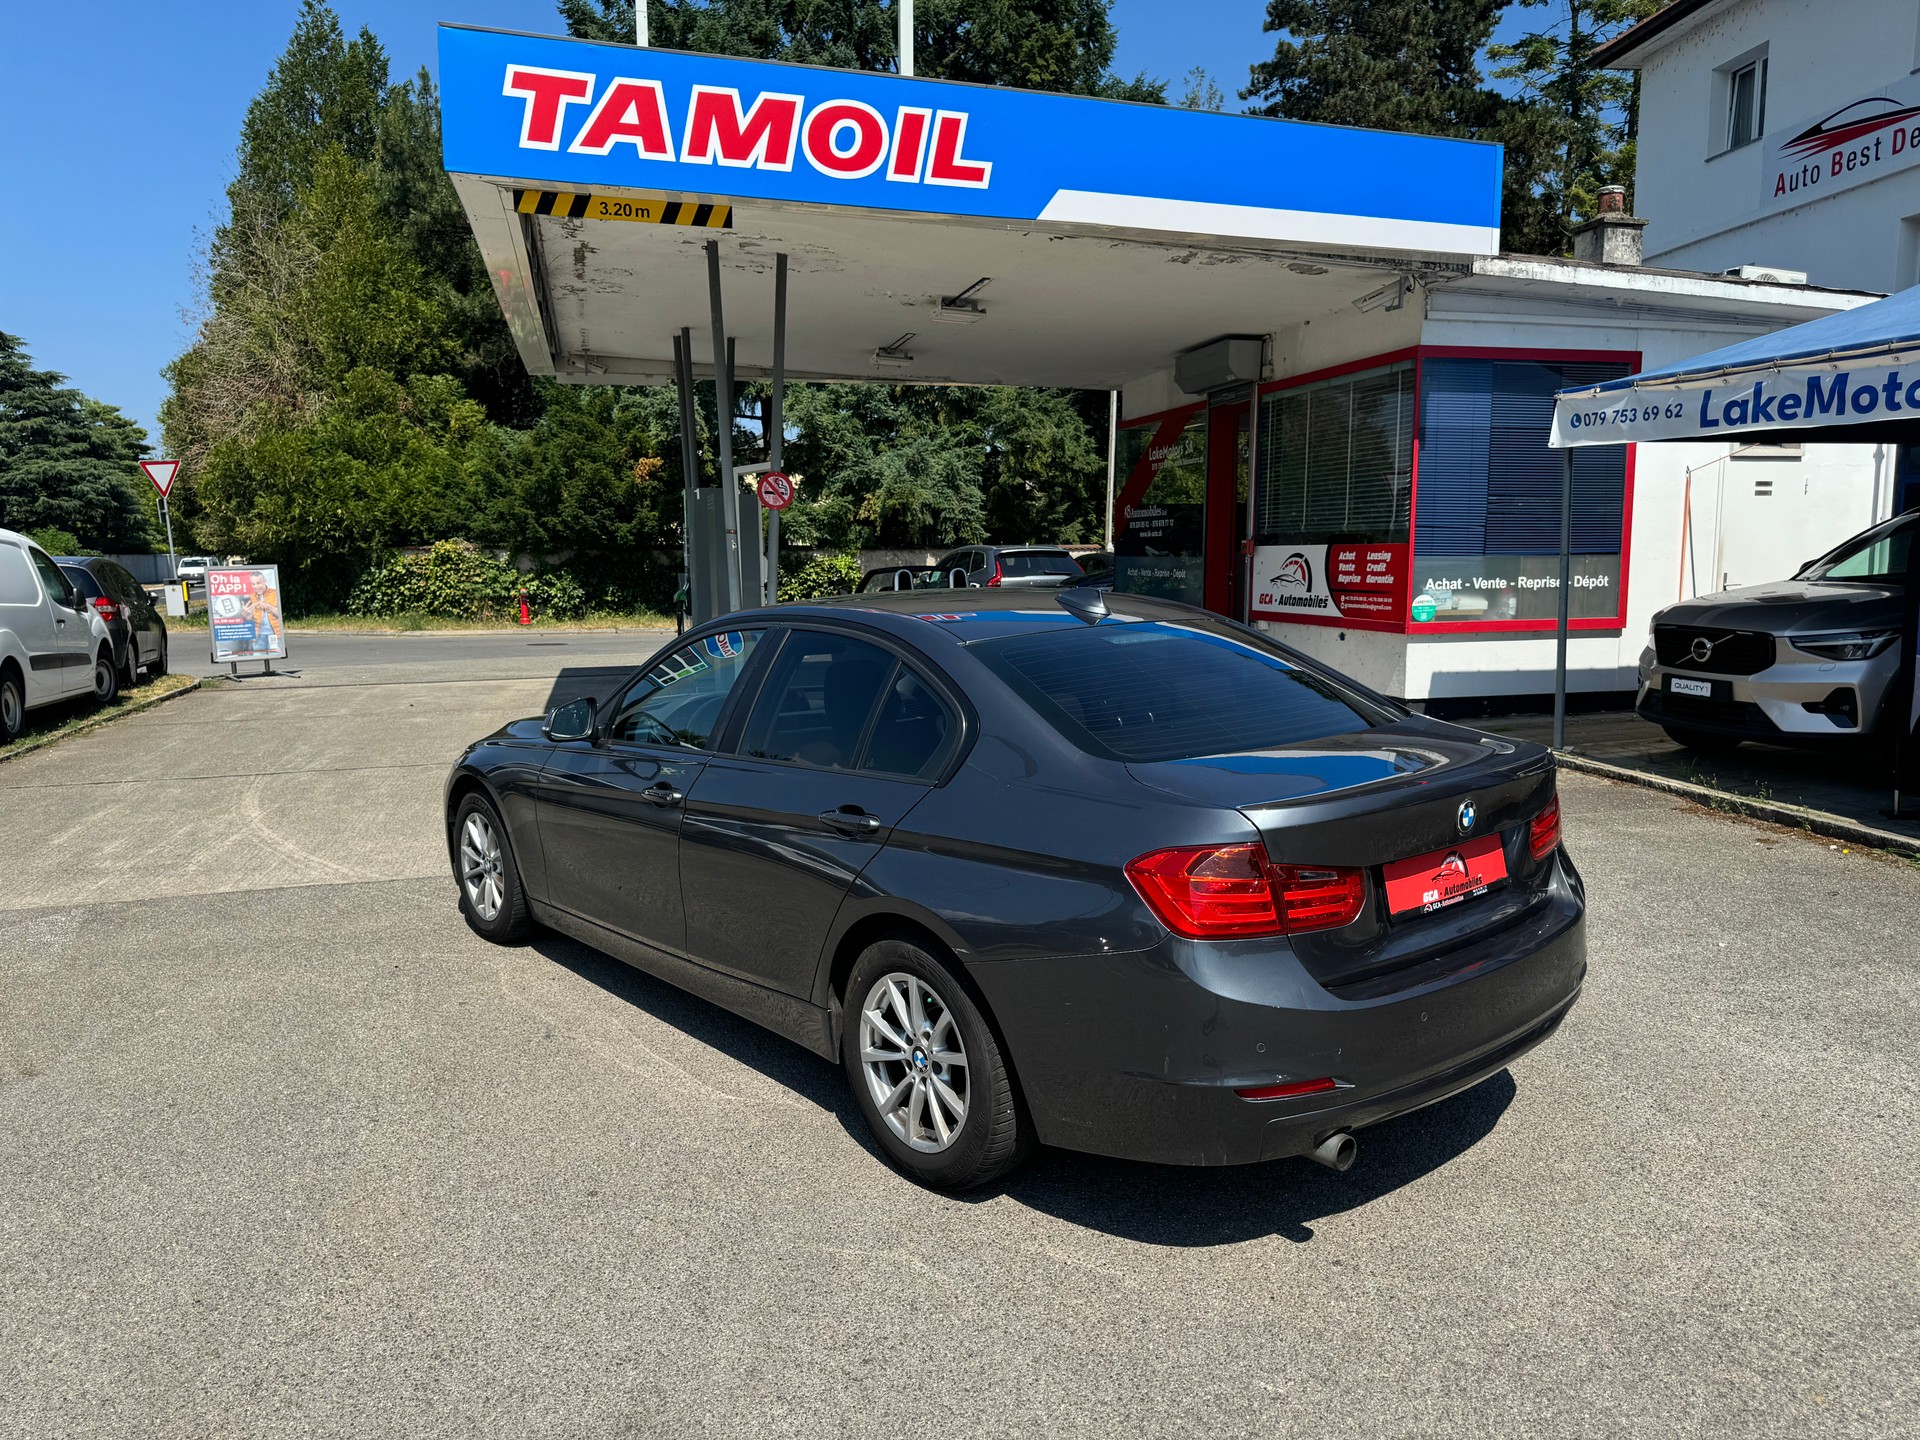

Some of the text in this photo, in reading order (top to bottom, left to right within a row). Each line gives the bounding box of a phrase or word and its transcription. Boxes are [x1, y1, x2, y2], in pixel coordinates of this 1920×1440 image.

[502, 64, 993, 189] TAMOIL
[1774, 127, 1920, 197] Auto Best De
[600, 201, 650, 218] 3.20 m
[1583, 403, 1683, 427] 079 753 69 62
[1339, 550, 1356, 560] Achat
[1366, 550, 1392, 562] Leasing
[1338, 563, 1356, 572] Vente
[210, 574, 240, 584] Oh la
[1338, 574, 1361, 584] Reprise
[1366, 574, 1394, 584] Garantie
[1426, 578, 1462, 590] Achat
[1472, 578, 1507, 590] Vente
[1518, 576, 1560, 591] Reprise
[1574, 575, 1608, 589] Dépôt
[1259, 593, 1273, 605] GCA
[1278, 594, 1328, 609] Automobiles
[1674, 682, 1704, 692] QUALITY
[1423, 890, 1439, 903] GCA
[1444, 876, 1482, 896] Automobiles
